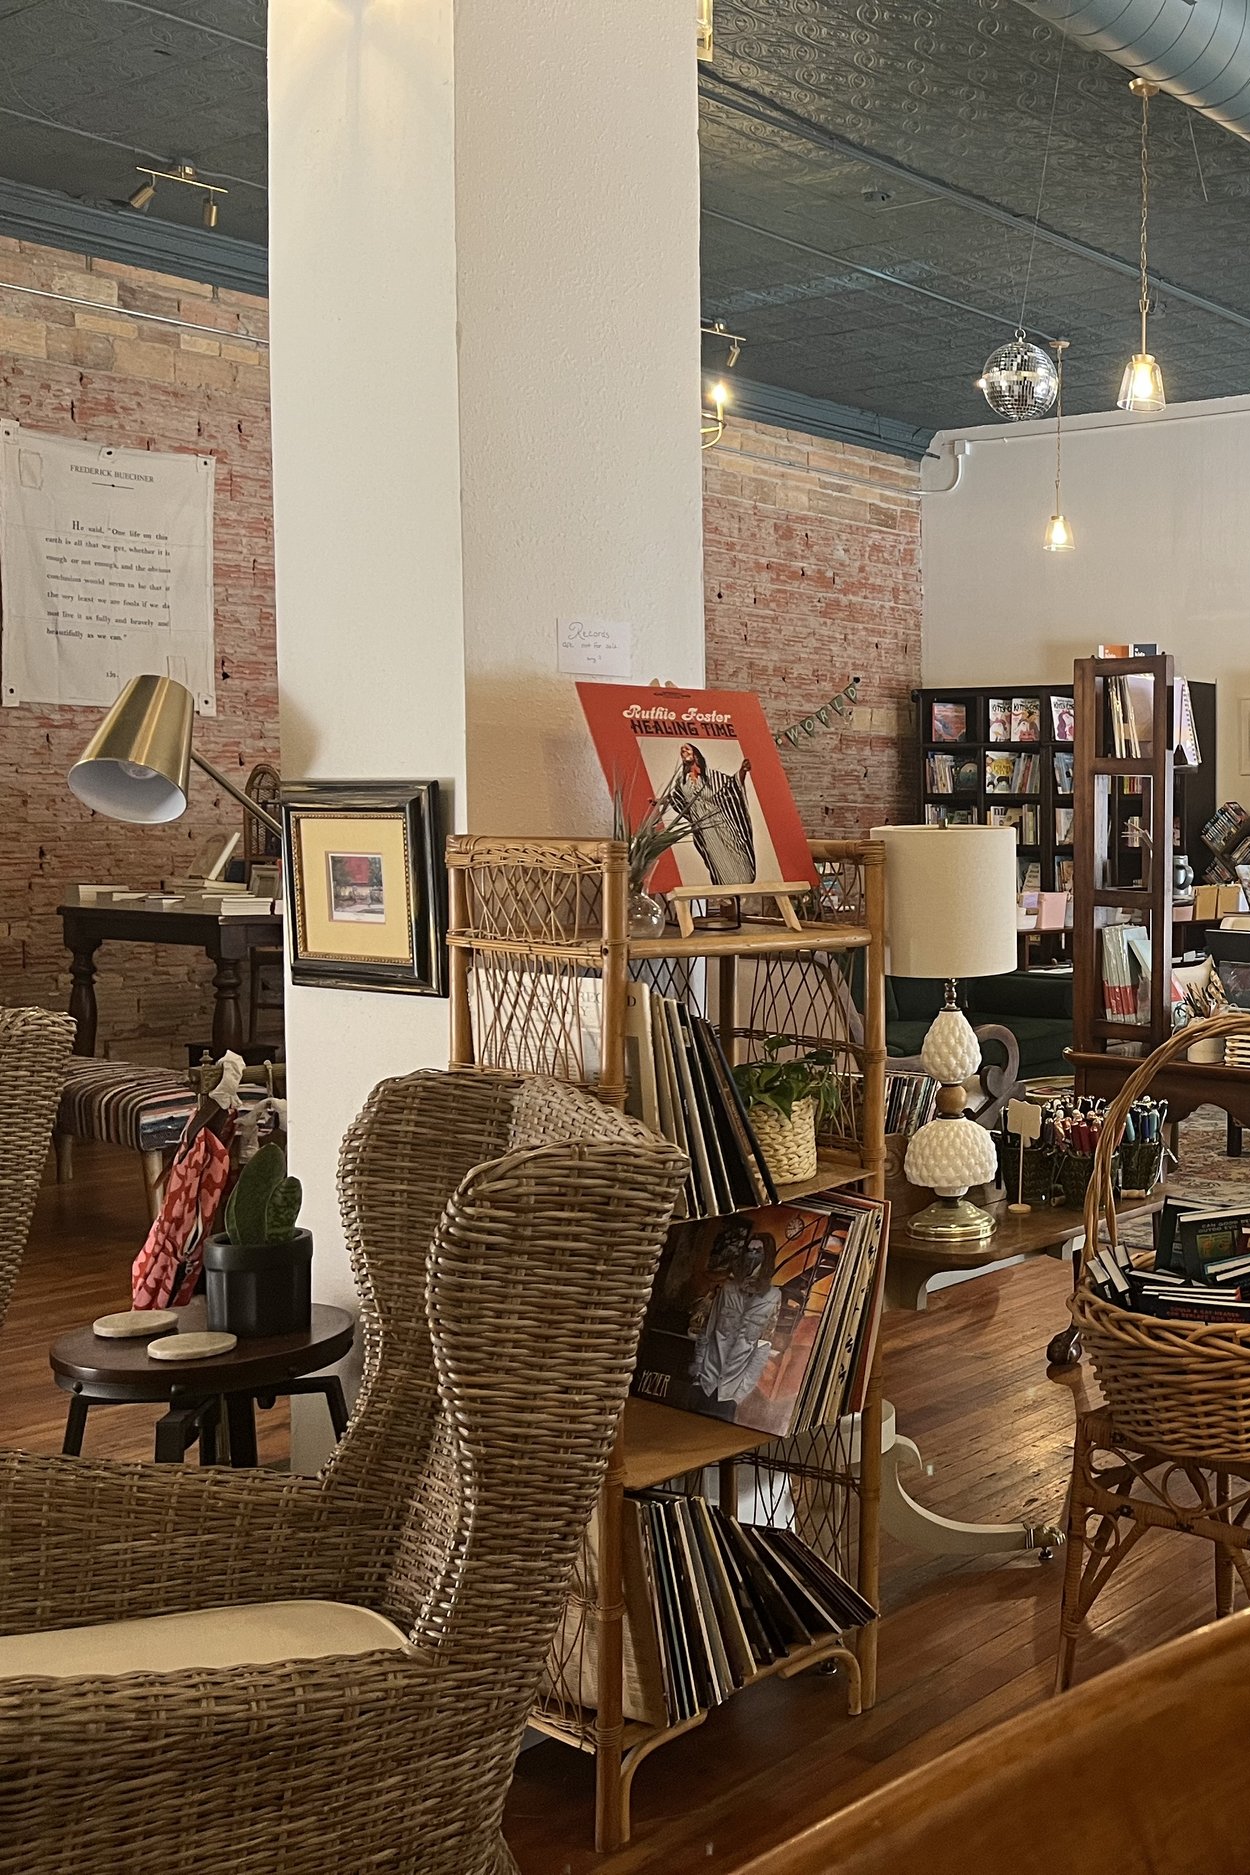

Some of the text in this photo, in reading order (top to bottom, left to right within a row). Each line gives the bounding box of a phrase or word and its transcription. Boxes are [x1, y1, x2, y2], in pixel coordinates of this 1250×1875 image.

[70, 464, 154, 482] FREDERICK BUECHNER
[72, 520, 84, 531] He
[129, 530, 140, 538] life
[156, 532, 168, 540] this
[45, 536, 62, 544] earth
[85, 540, 99, 548] that
[128, 546, 155, 555] whether
[46, 555, 67, 564] enough
[147, 565, 171, 573] obvious
[46, 573, 81, 583] conclusion
[138, 582, 146, 590] be
[62, 593, 74, 602] very
[78, 594, 94, 603] least
[123, 599, 140, 607] fools
[96, 615, 111, 624] fully
[130, 618, 154, 626] bravely
[46, 627, 83, 640] beautifully
[567, 621, 610, 640] Records
[622, 704, 732, 723] Ruthie Foster
[630, 719, 737, 737] HEALING TIME
[637, 1370, 671, 1398] HOZIER
